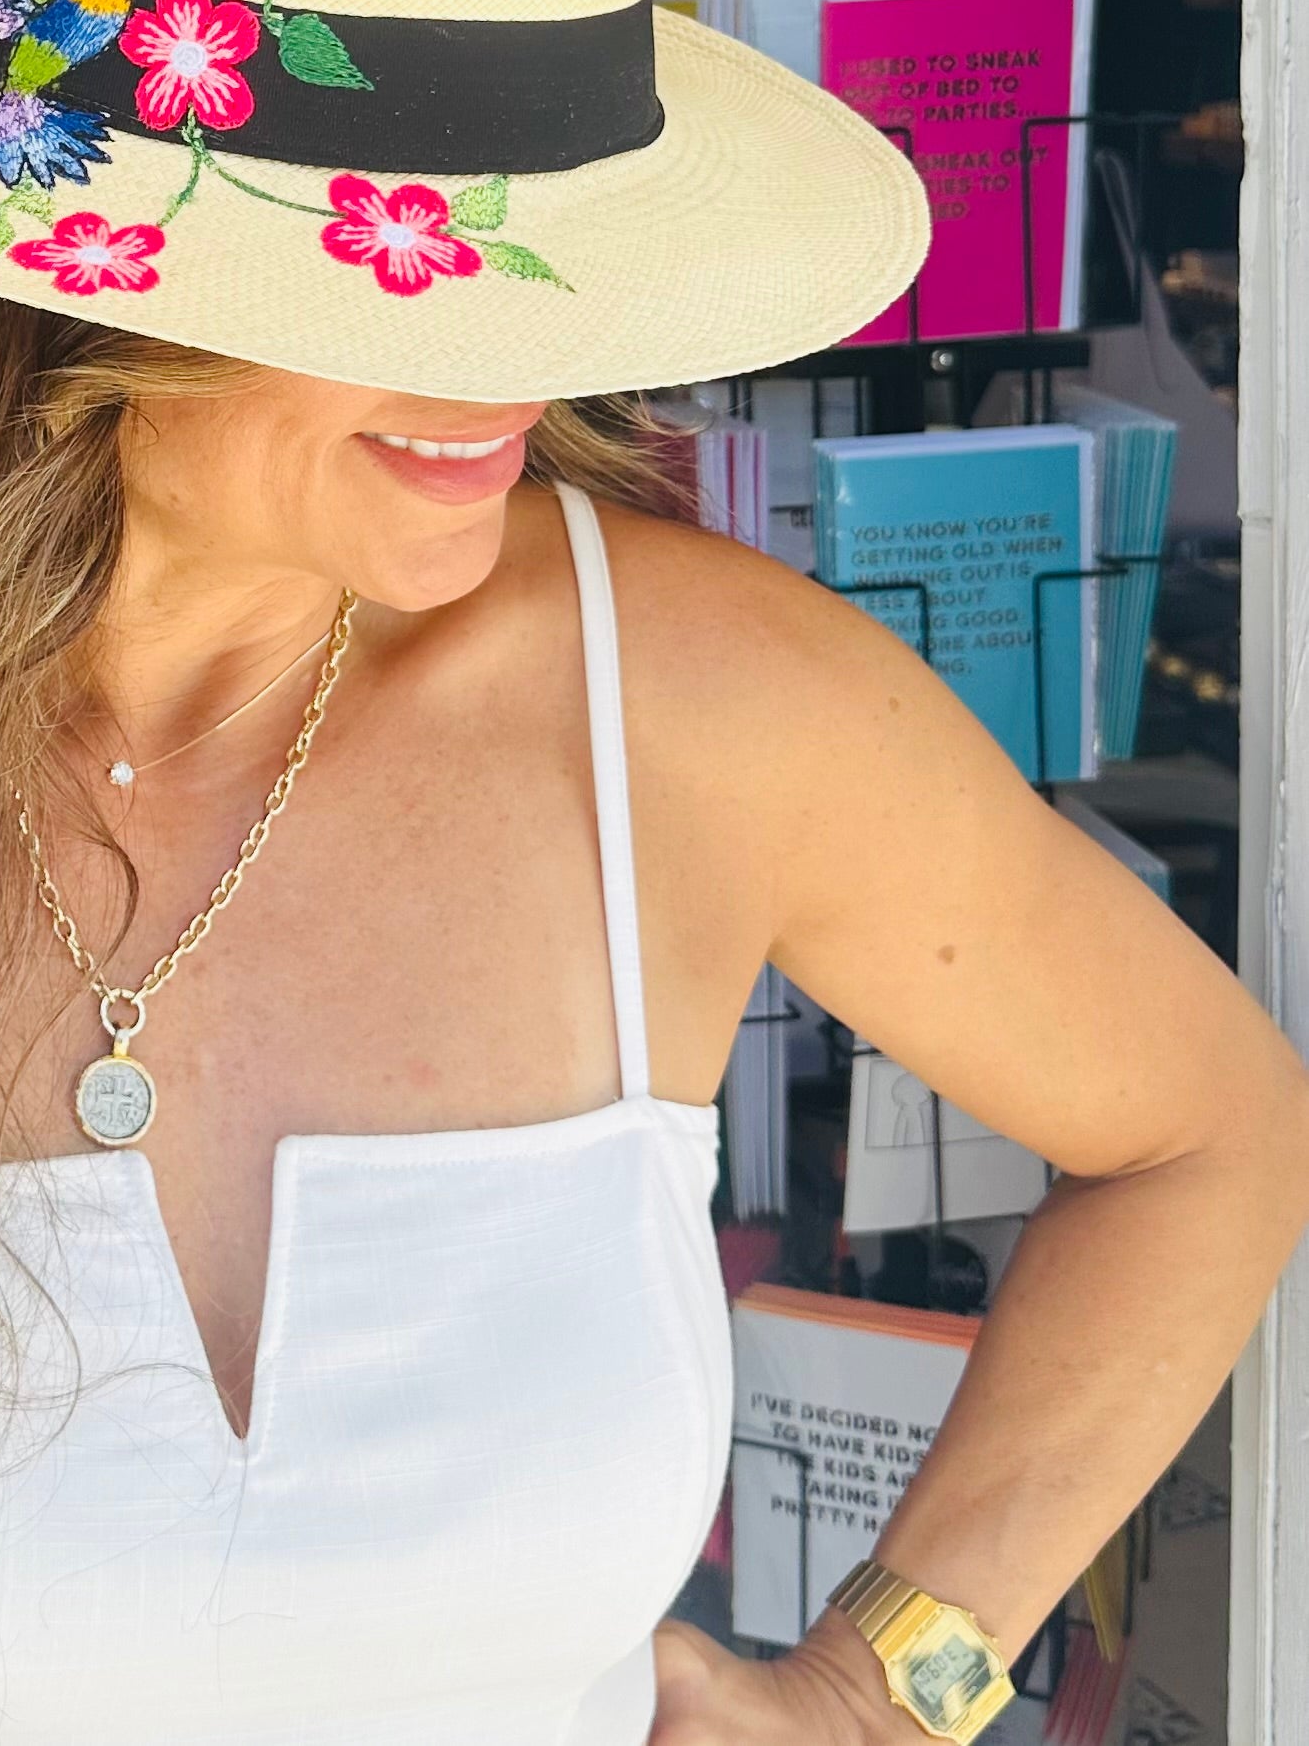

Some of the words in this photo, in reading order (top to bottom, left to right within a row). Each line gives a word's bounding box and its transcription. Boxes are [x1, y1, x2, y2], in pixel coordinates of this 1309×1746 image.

[927, 54, 956, 73] TO
[965, 49, 1041, 72] SNEAK
[898, 82, 930, 101] OF
[936, 78, 980, 98] BED
[991, 75, 1020, 94] TO
[982, 173, 1010, 192] TO
[852, 523, 895, 544] YOU
[903, 520, 966, 541] KNOW
[974, 512, 1054, 533] YOU'RE
[851, 545, 946, 567] GETTING
[952, 539, 994, 559] OLD
[1002, 536, 1063, 556] WHEN
[960, 563, 1008, 582] OUT
[1010, 561, 1033, 578] IS
[955, 608, 1020, 629] GOOD
[751, 1392, 793, 1416] I'VE
[801, 1403, 898, 1437] DECIDED
[907, 1422, 940, 1444] NO
[771, 1421, 800, 1443] TO
[808, 1431, 865, 1455] HAVE
[824, 1456, 877, 1483] KIDS
[802, 1477, 878, 1508] AKING
